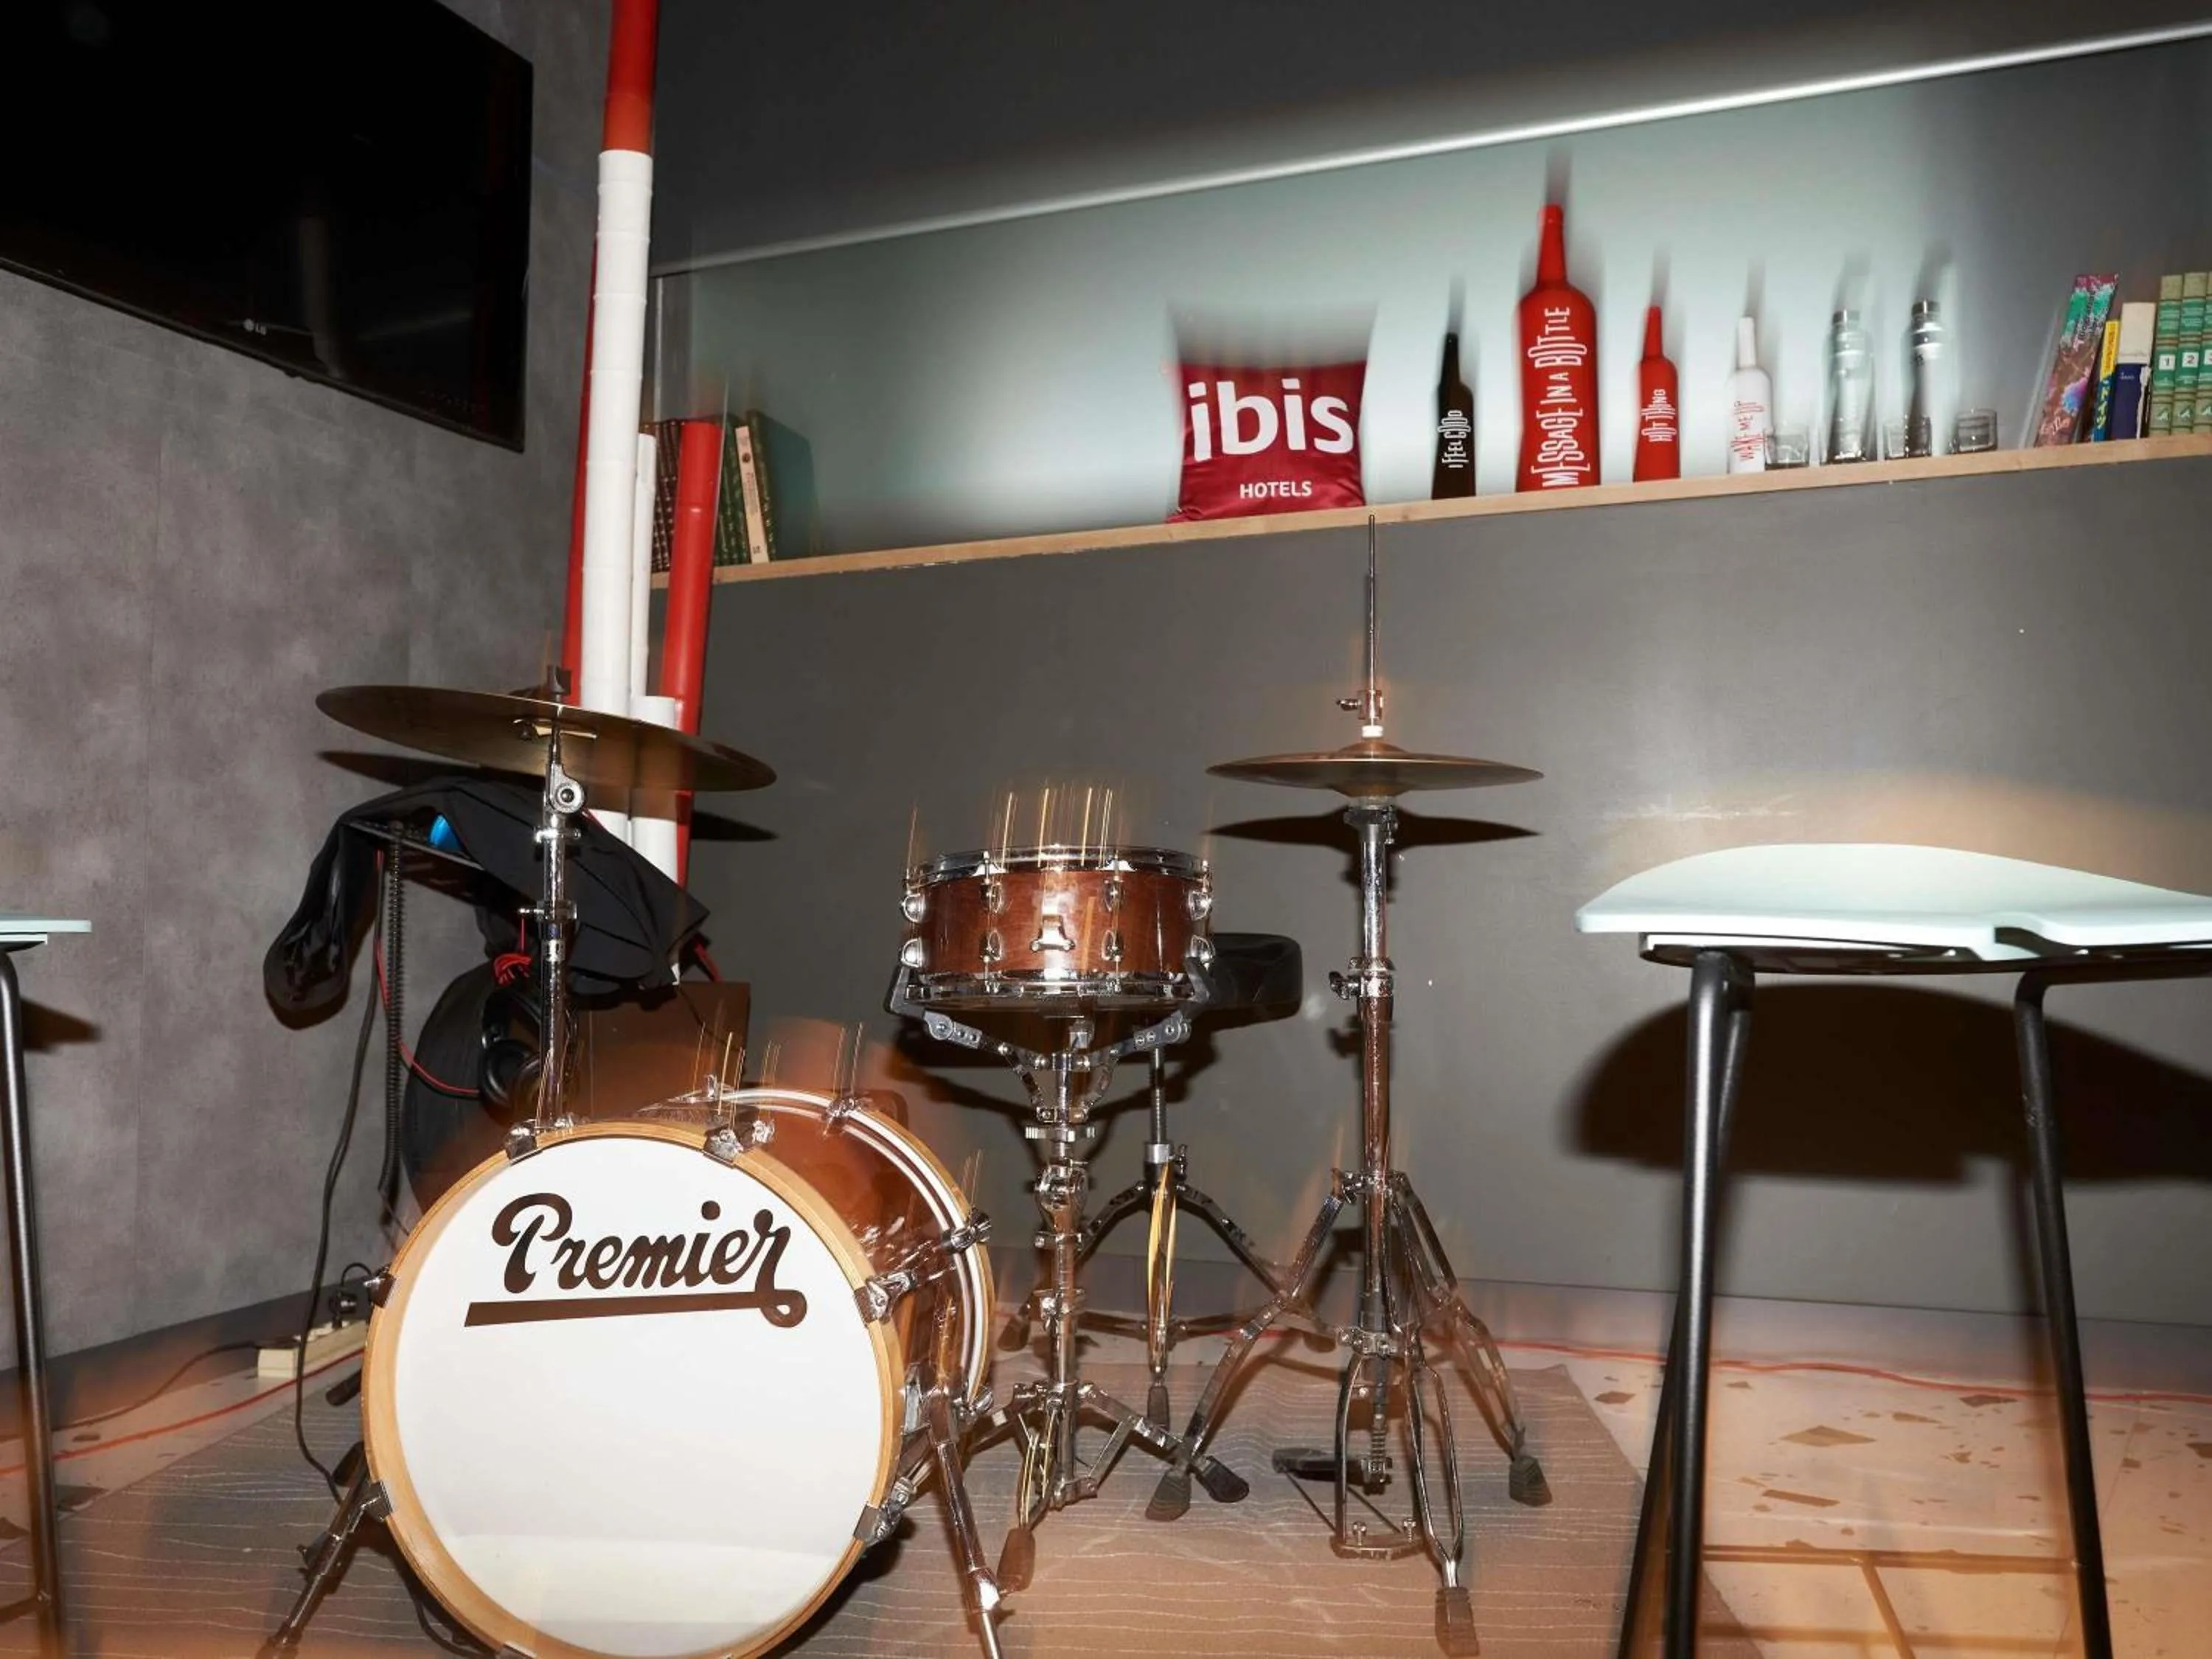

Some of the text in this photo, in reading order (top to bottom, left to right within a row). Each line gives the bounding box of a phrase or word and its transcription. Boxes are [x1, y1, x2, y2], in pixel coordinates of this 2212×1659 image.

[1188, 378, 1354, 462] ibis
[1528, 307, 1590, 487] MESSAGE IN A BOTTLE
[1441, 439, 1469, 463] FEEL
[1641, 421, 1677, 442] HOT
[1239, 481, 1312, 498] HOTELS
[490, 1192, 808, 1327] Premier
